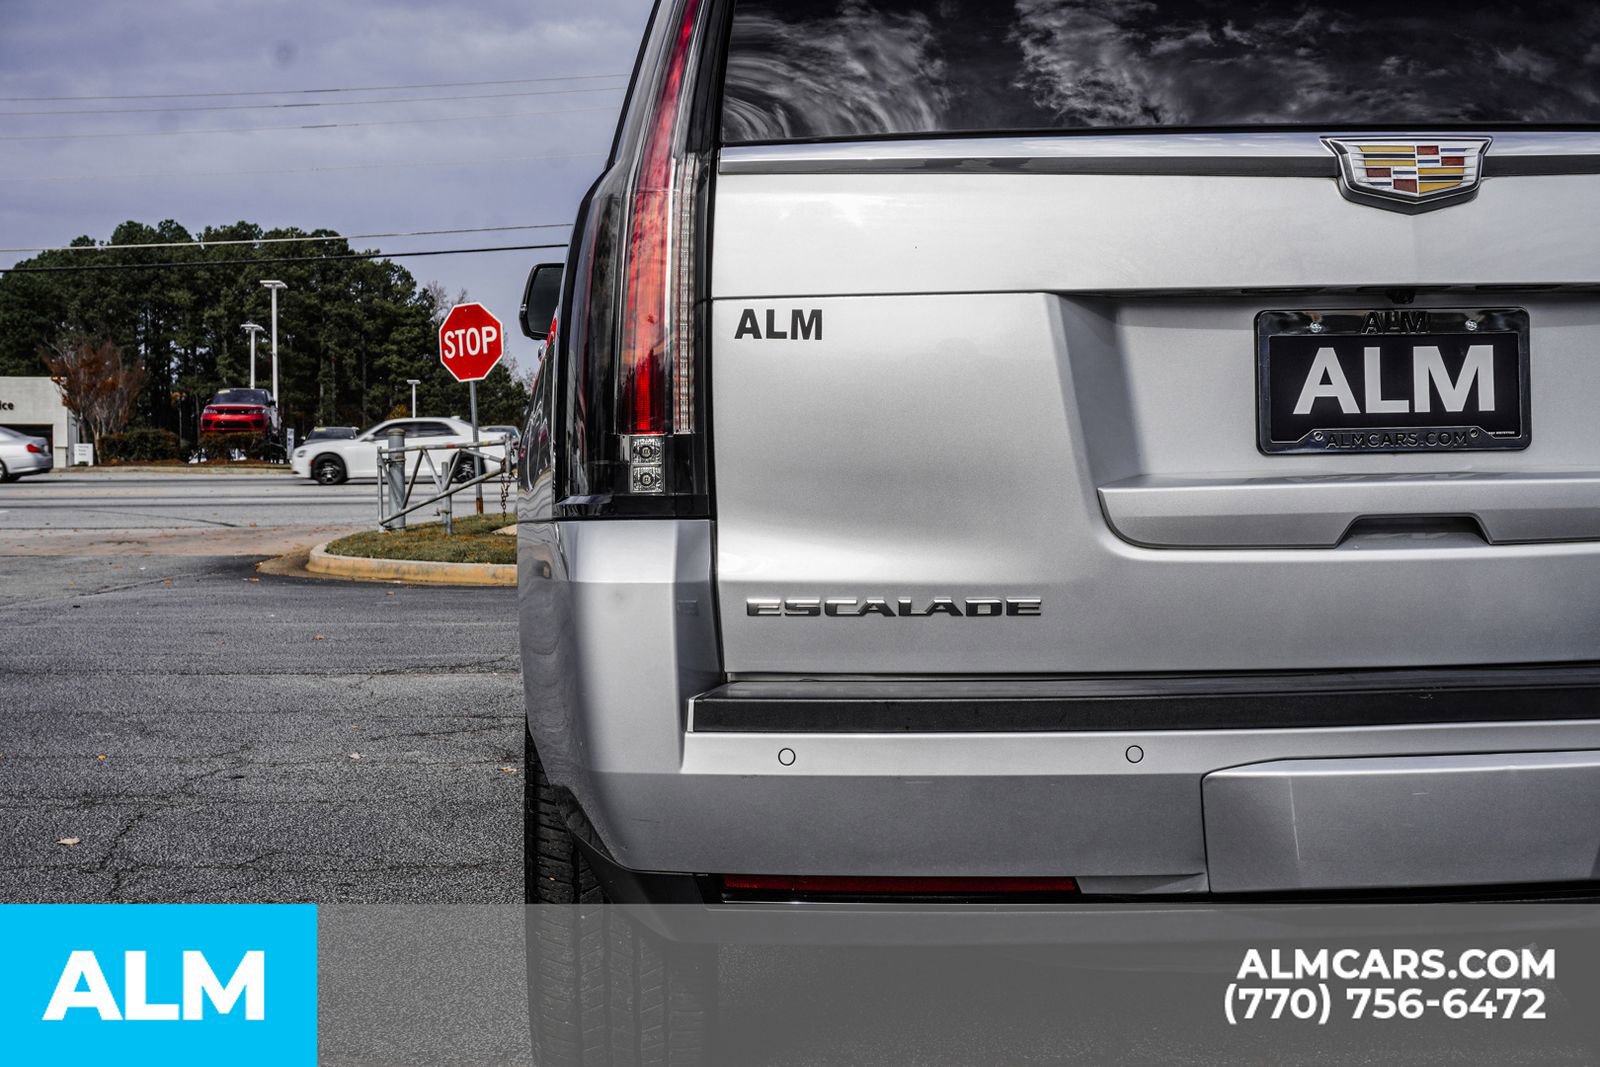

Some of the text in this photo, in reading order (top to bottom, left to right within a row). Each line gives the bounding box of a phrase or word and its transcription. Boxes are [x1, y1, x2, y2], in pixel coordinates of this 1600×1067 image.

[734, 308, 822, 340] ALM
[444, 326, 497, 359] STOP
[1292, 344, 1496, 415] ALM
[1325, 431, 1468, 449] ALMCARS.COM
[746, 597, 1041, 617] ESCALADE
